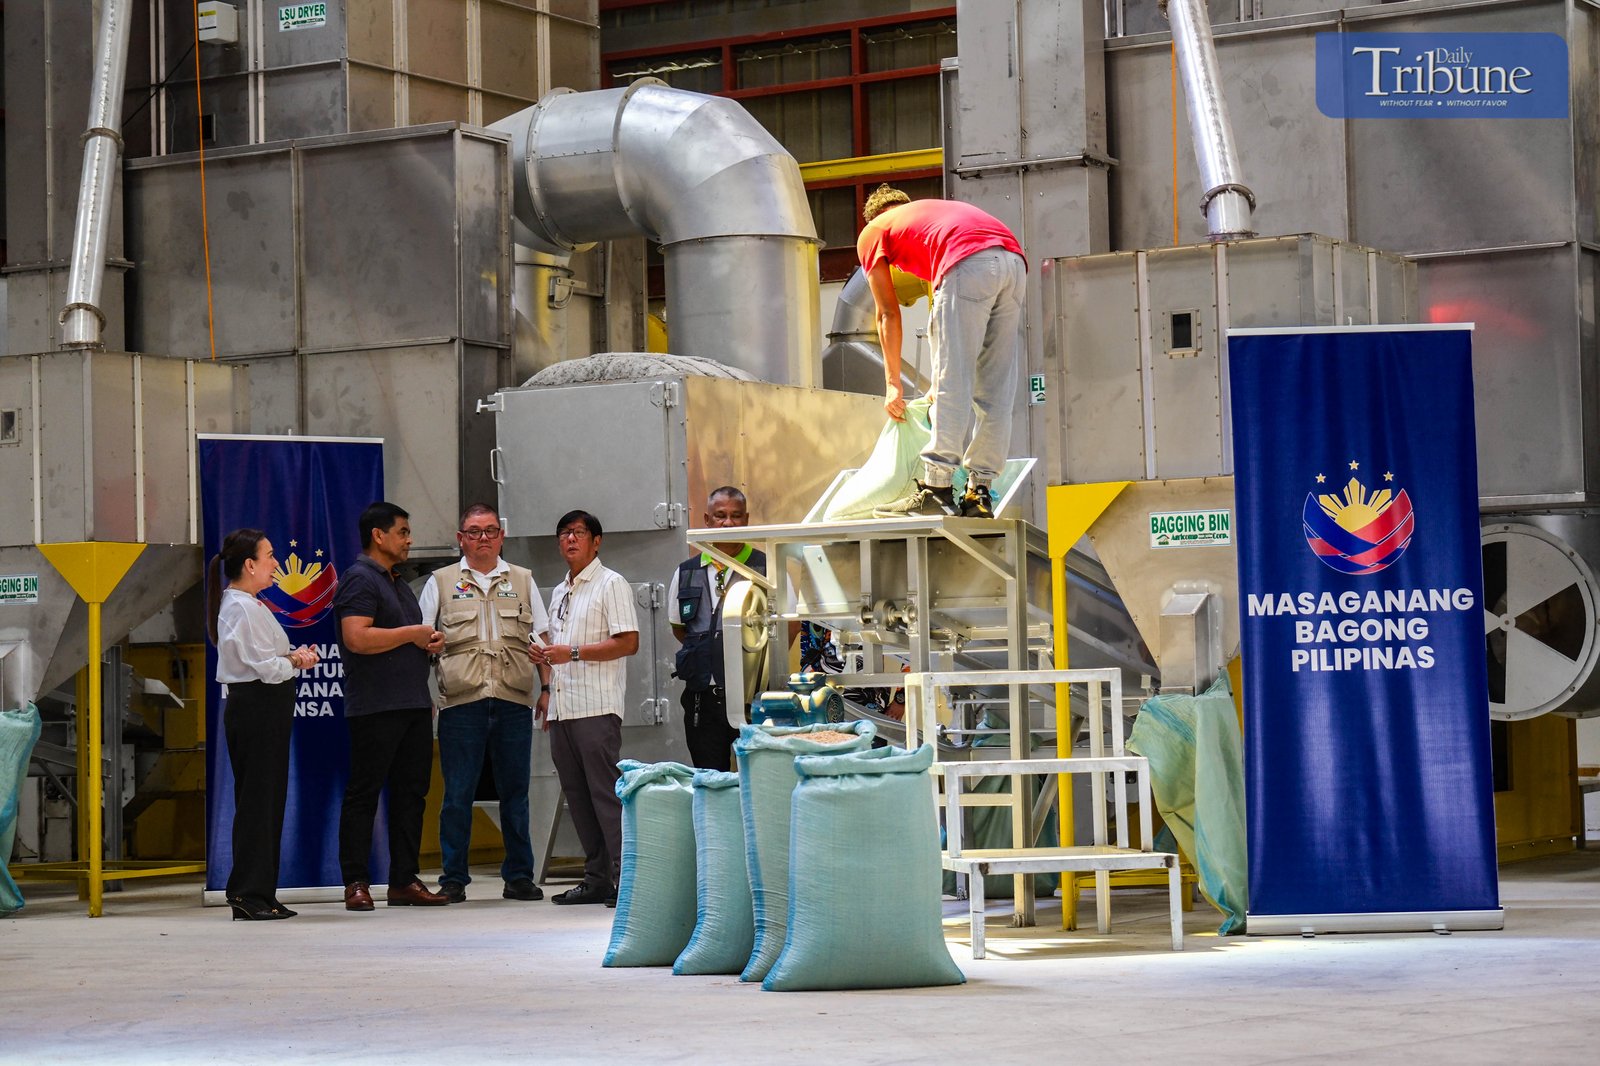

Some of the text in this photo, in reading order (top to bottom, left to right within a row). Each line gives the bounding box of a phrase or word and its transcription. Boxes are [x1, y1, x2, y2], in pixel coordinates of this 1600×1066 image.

[280, 4, 325, 20] LSU DRYER
[1151, 513, 1229, 534] BAGGING BIN
[0, 577, 38, 593] GING BIN
[1247, 588, 1475, 617] MASAGANANG
[1295, 617, 1429, 644] BAGONG
[1292, 645, 1435, 672] PILIPINAS
[293, 701, 335, 718] NSA
